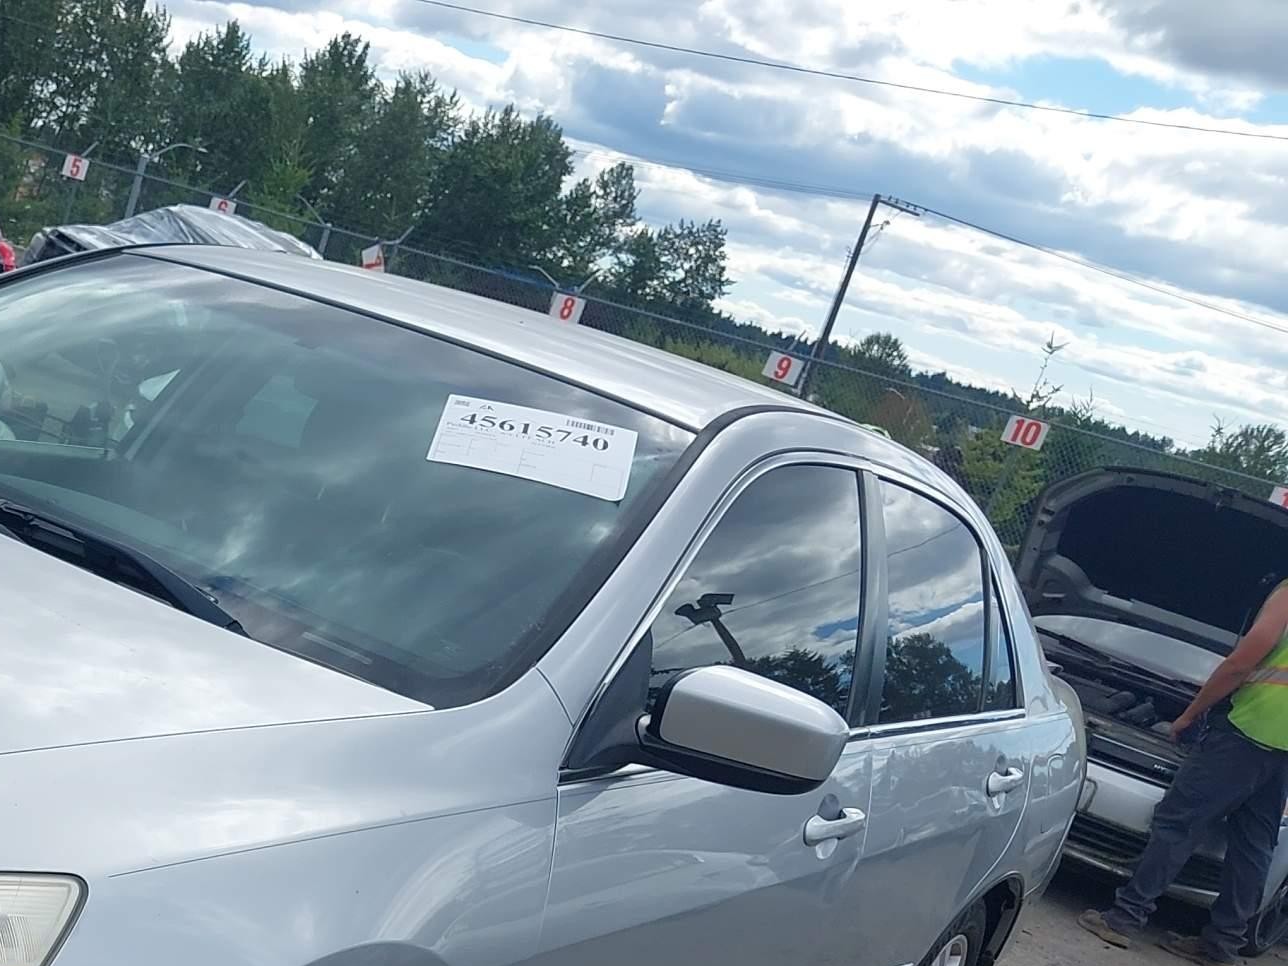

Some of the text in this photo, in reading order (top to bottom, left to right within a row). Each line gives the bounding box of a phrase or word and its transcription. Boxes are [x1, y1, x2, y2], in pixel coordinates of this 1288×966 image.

[70, 158, 82, 177] 5
[560, 297, 575, 320] 8
[774, 356, 792, 379] 9
[459, 412, 609, 451] 45615740
[1010, 419, 1042, 446] 10
